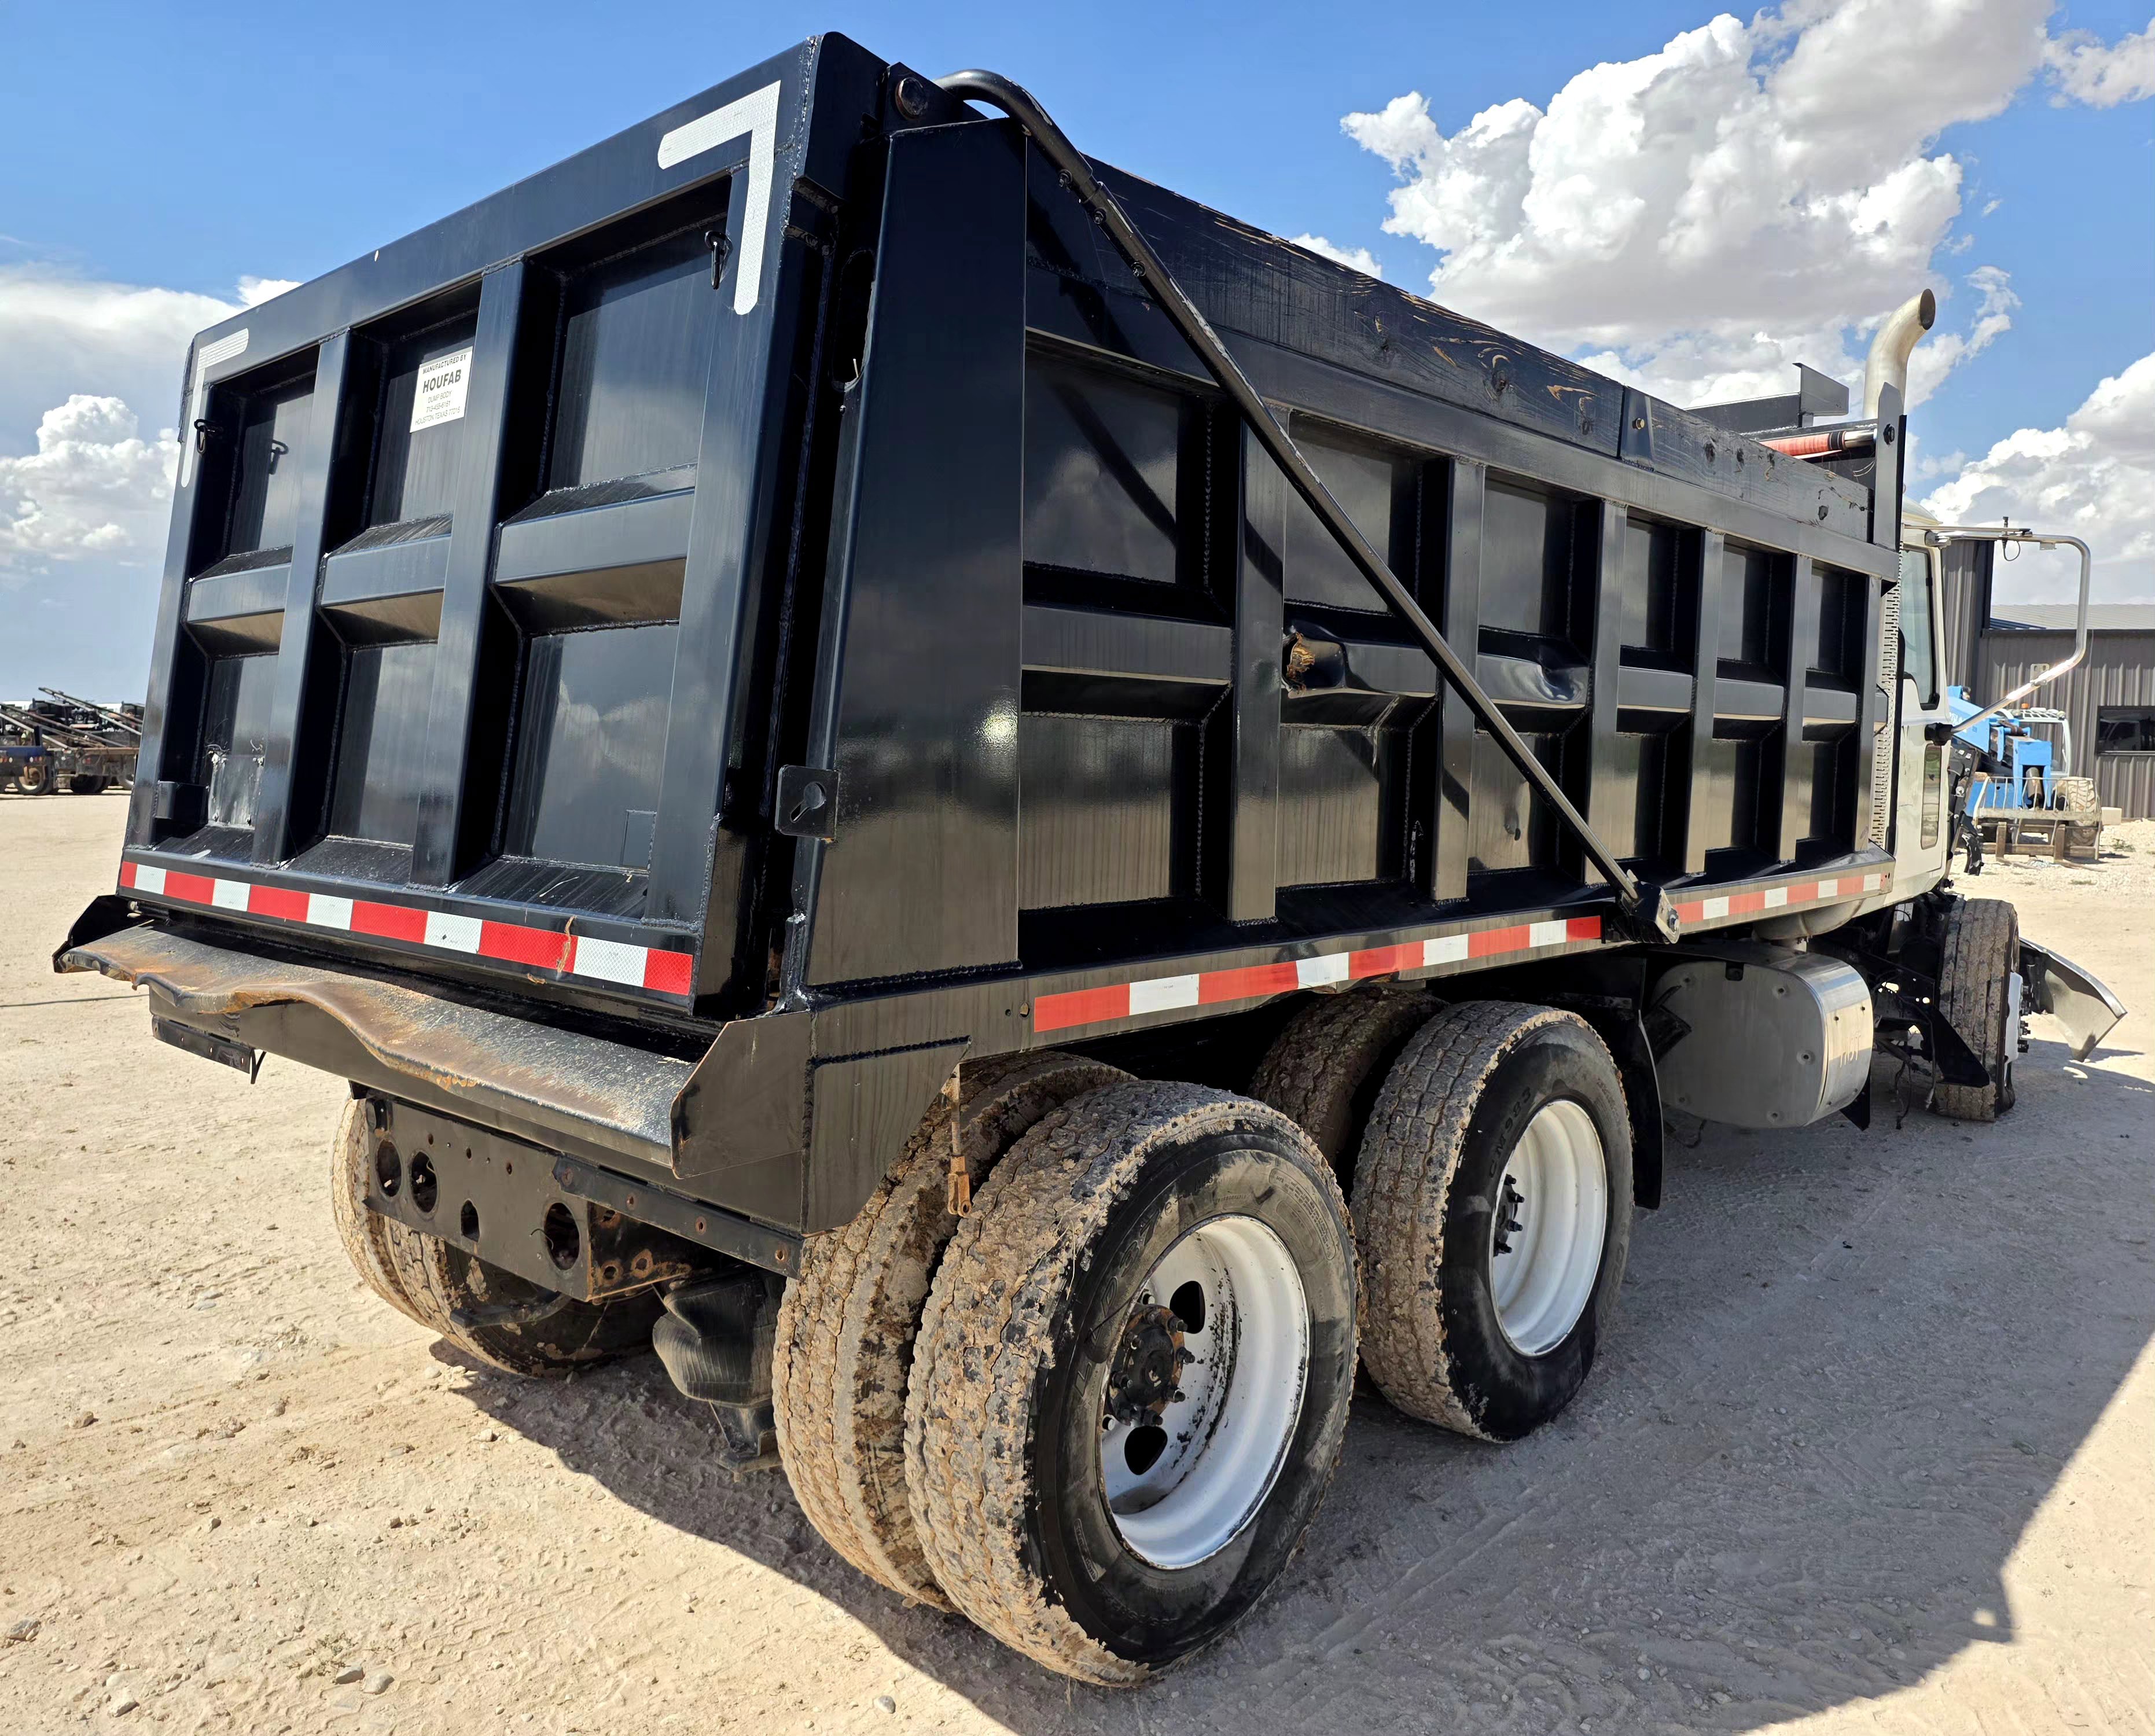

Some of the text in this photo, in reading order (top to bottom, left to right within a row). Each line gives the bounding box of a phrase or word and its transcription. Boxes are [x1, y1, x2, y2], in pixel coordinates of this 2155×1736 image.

[422, 354, 467, 374] MANUFACTURED BY
[422, 369, 462, 393] HOUFAB
[440, 390, 452, 400] BODY
[415, 415, 434, 426] HOUSTON
[435, 410, 448, 420] TEXAS
